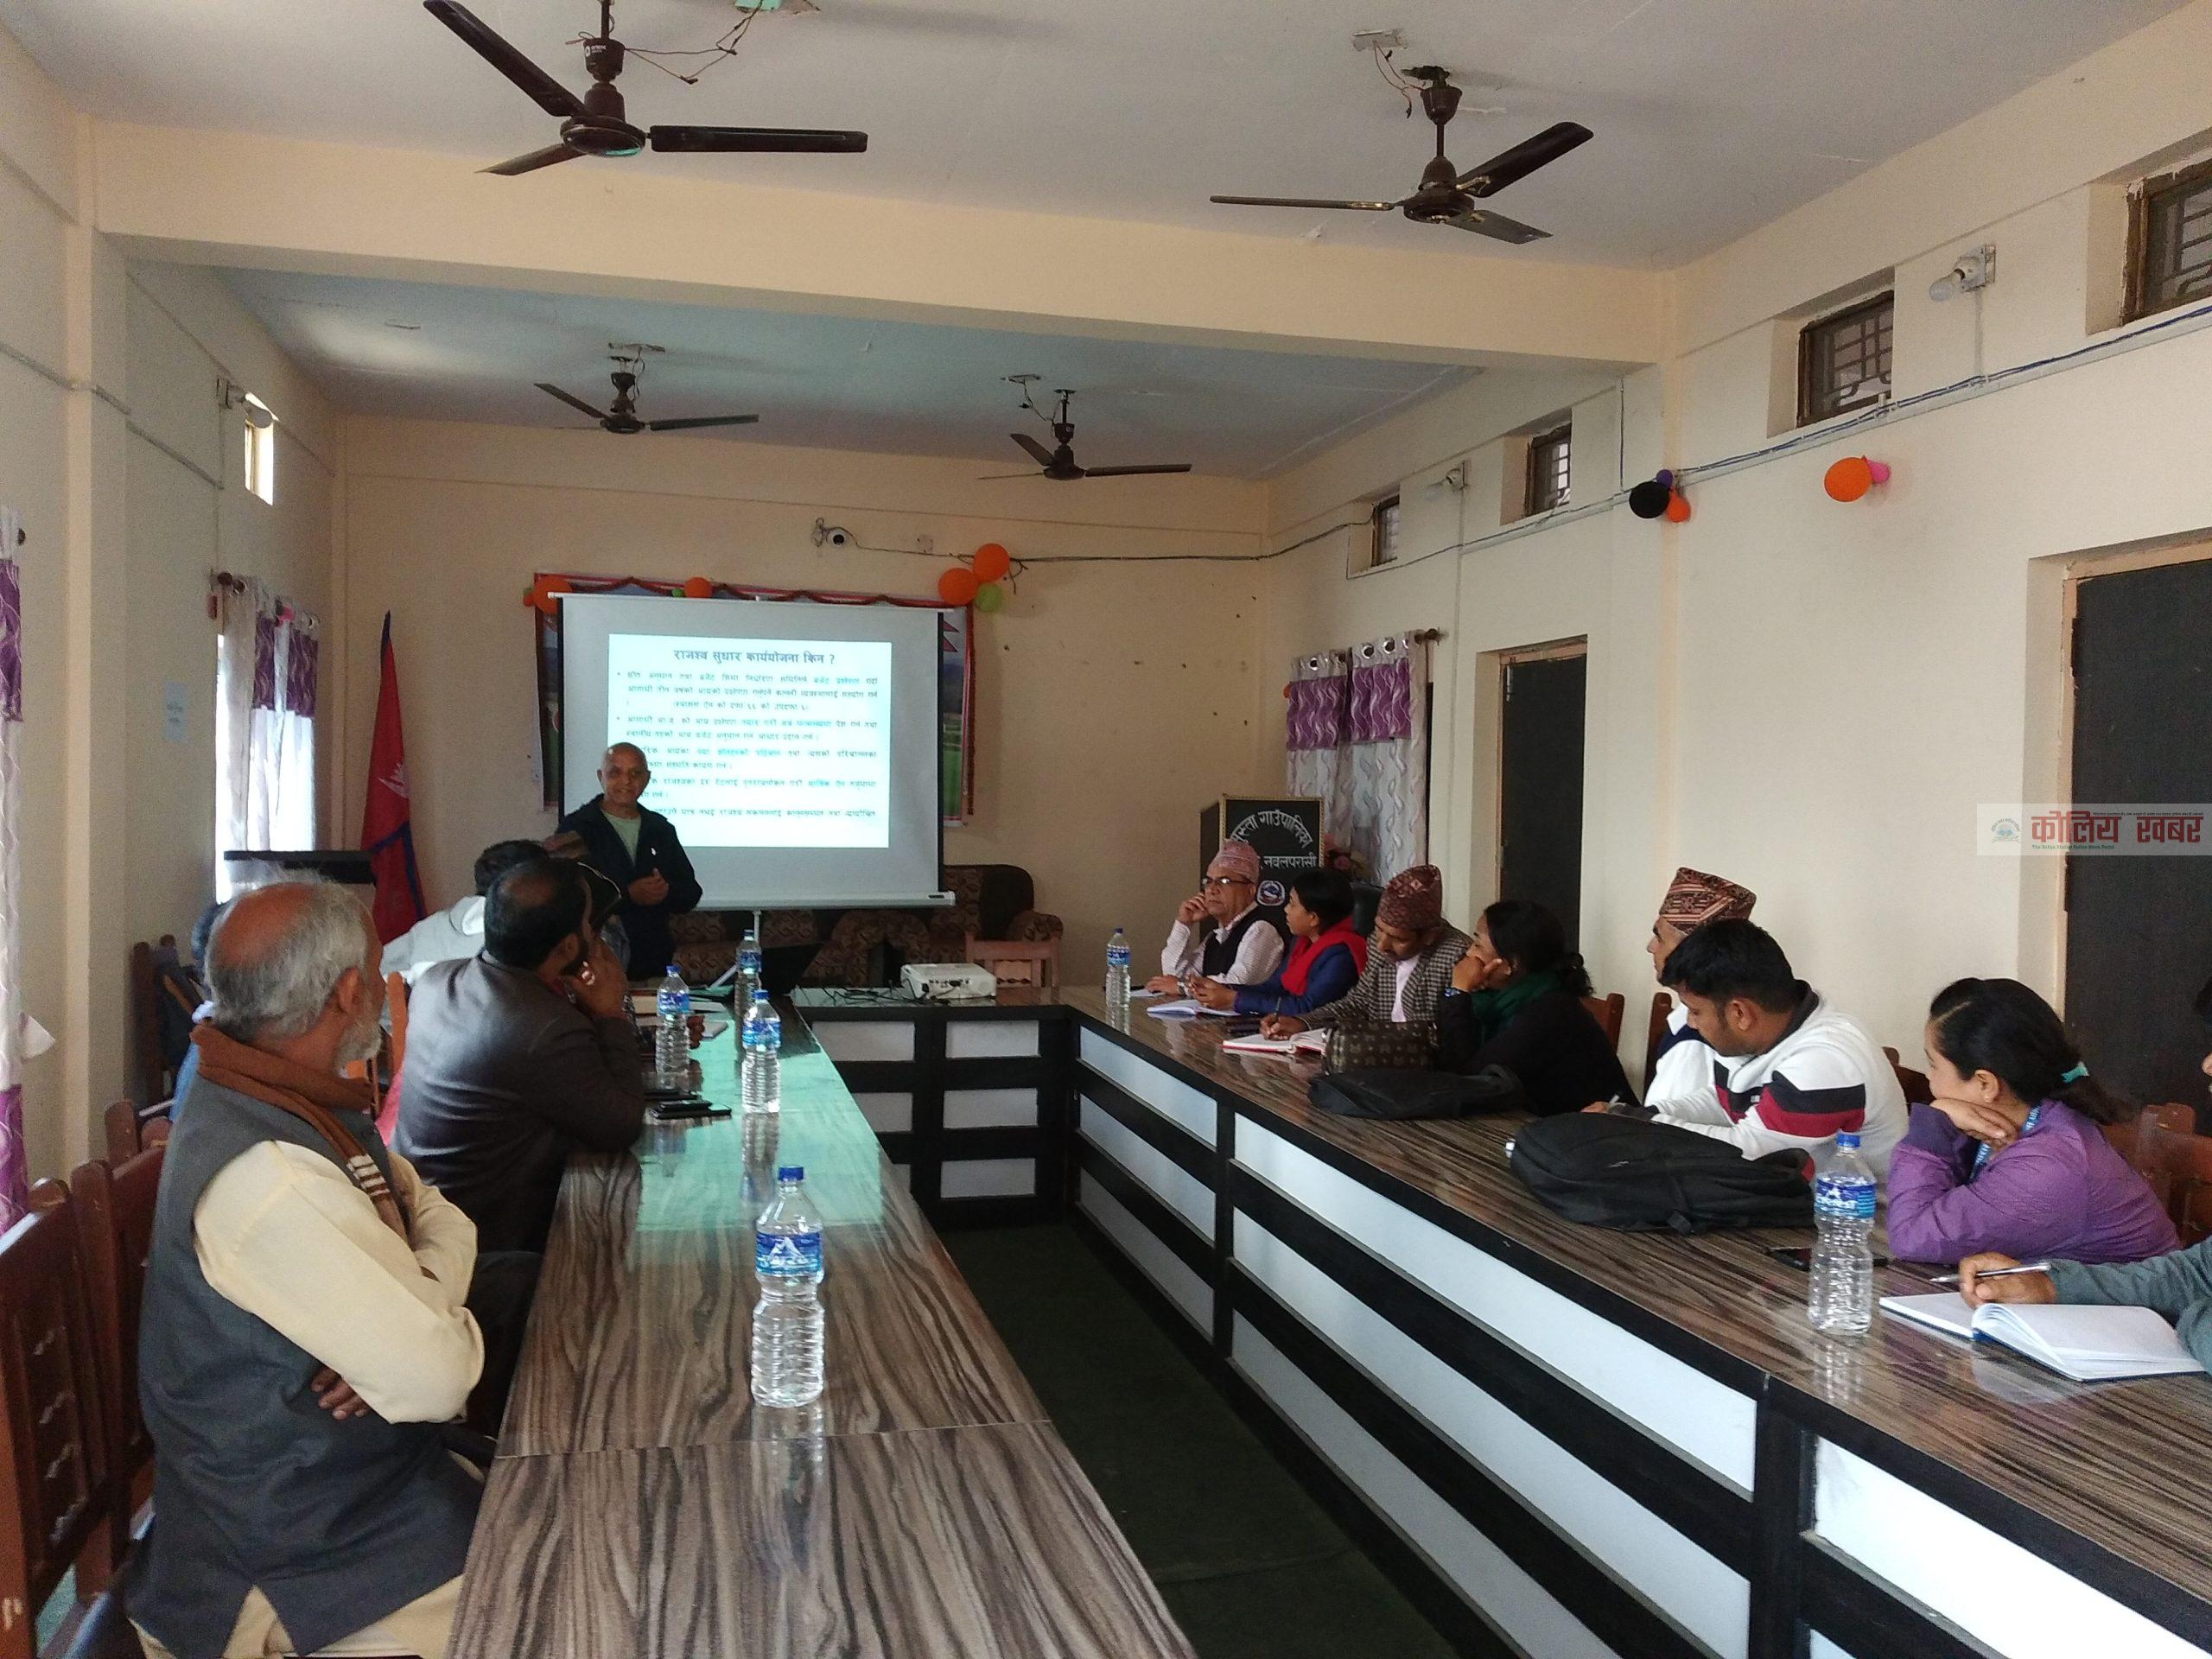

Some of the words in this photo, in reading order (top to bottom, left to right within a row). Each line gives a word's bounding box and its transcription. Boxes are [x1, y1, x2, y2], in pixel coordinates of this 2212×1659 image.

[713, 652, 741, 664] सुधार
[803, 650, 823, 664] किन
[830, 654, 836, 664] ?
